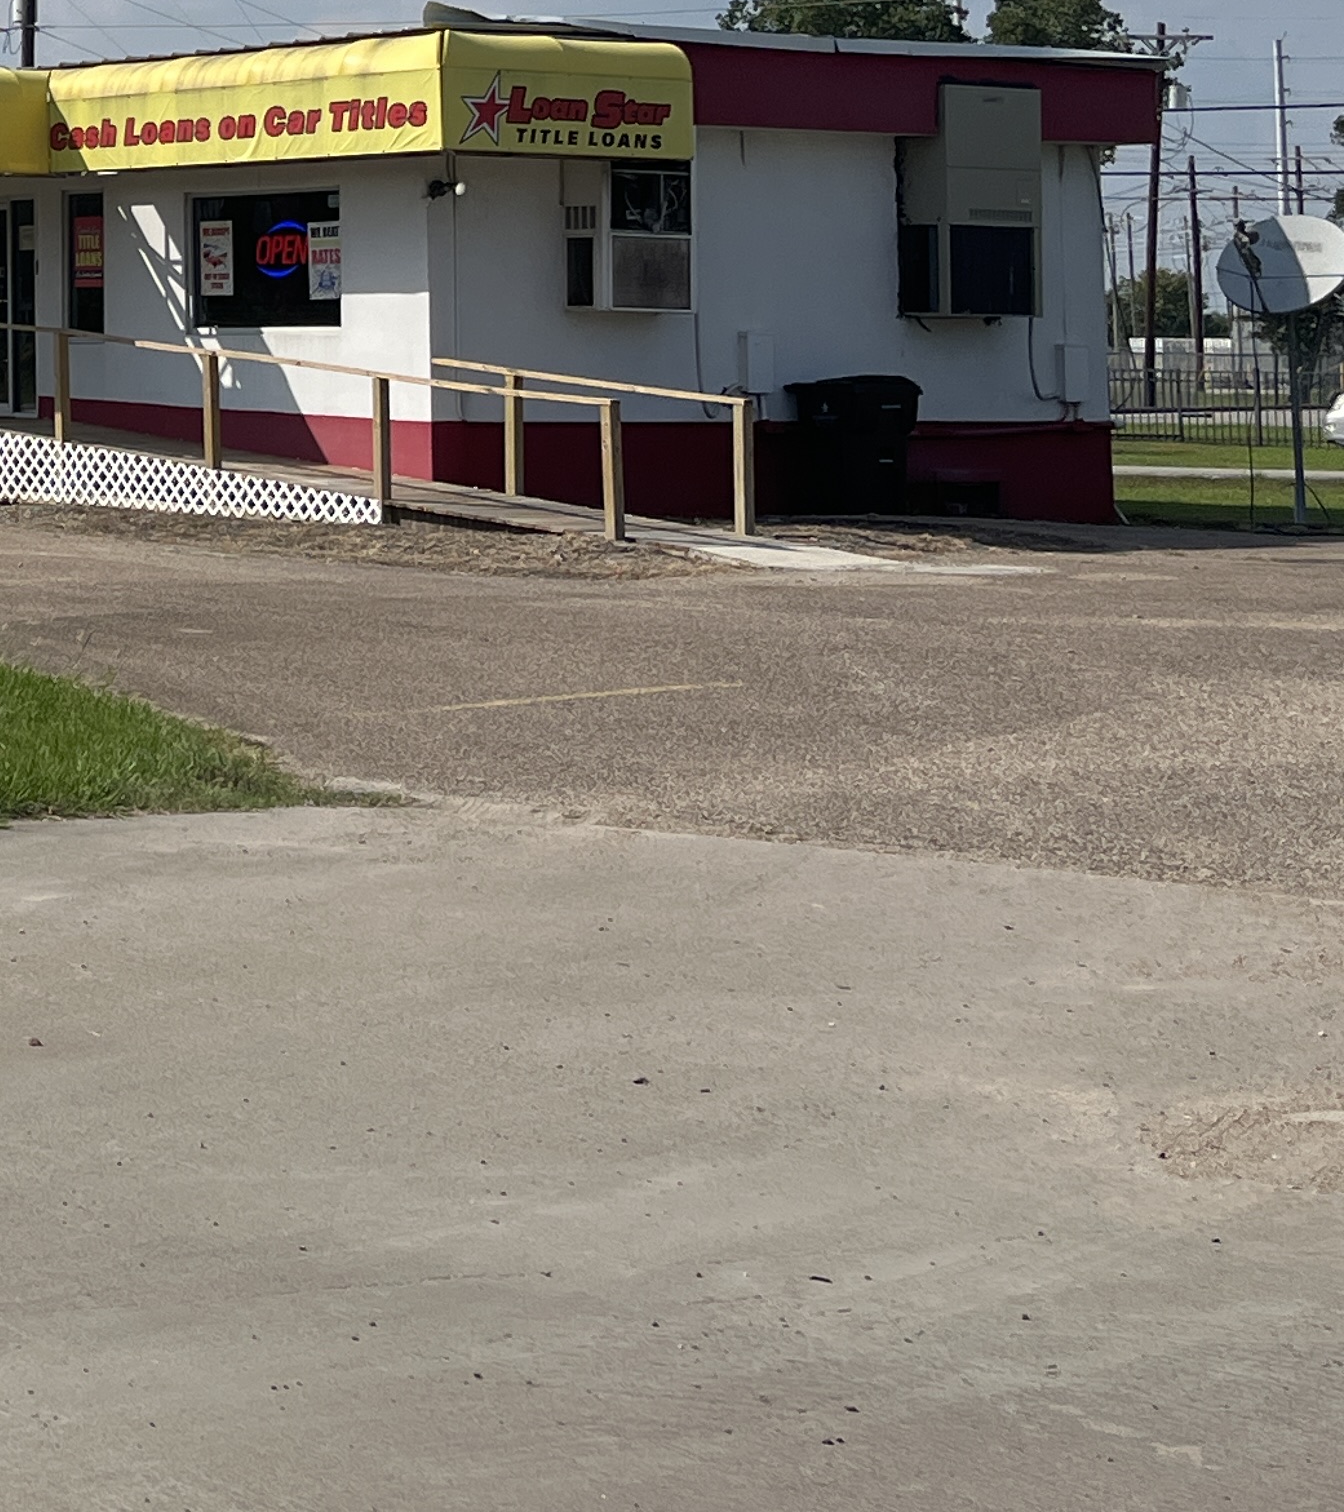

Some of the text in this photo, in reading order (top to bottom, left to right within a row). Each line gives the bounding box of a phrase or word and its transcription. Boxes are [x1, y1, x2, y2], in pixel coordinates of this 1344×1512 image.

[506, 86, 671, 129] Loan Star
[50, 96, 428, 151] Cash Loans on Car Titles
[516, 128, 663, 149] TITLE LOANS
[256, 235, 308, 265] OPEN
[312, 248, 341, 264] RATES
